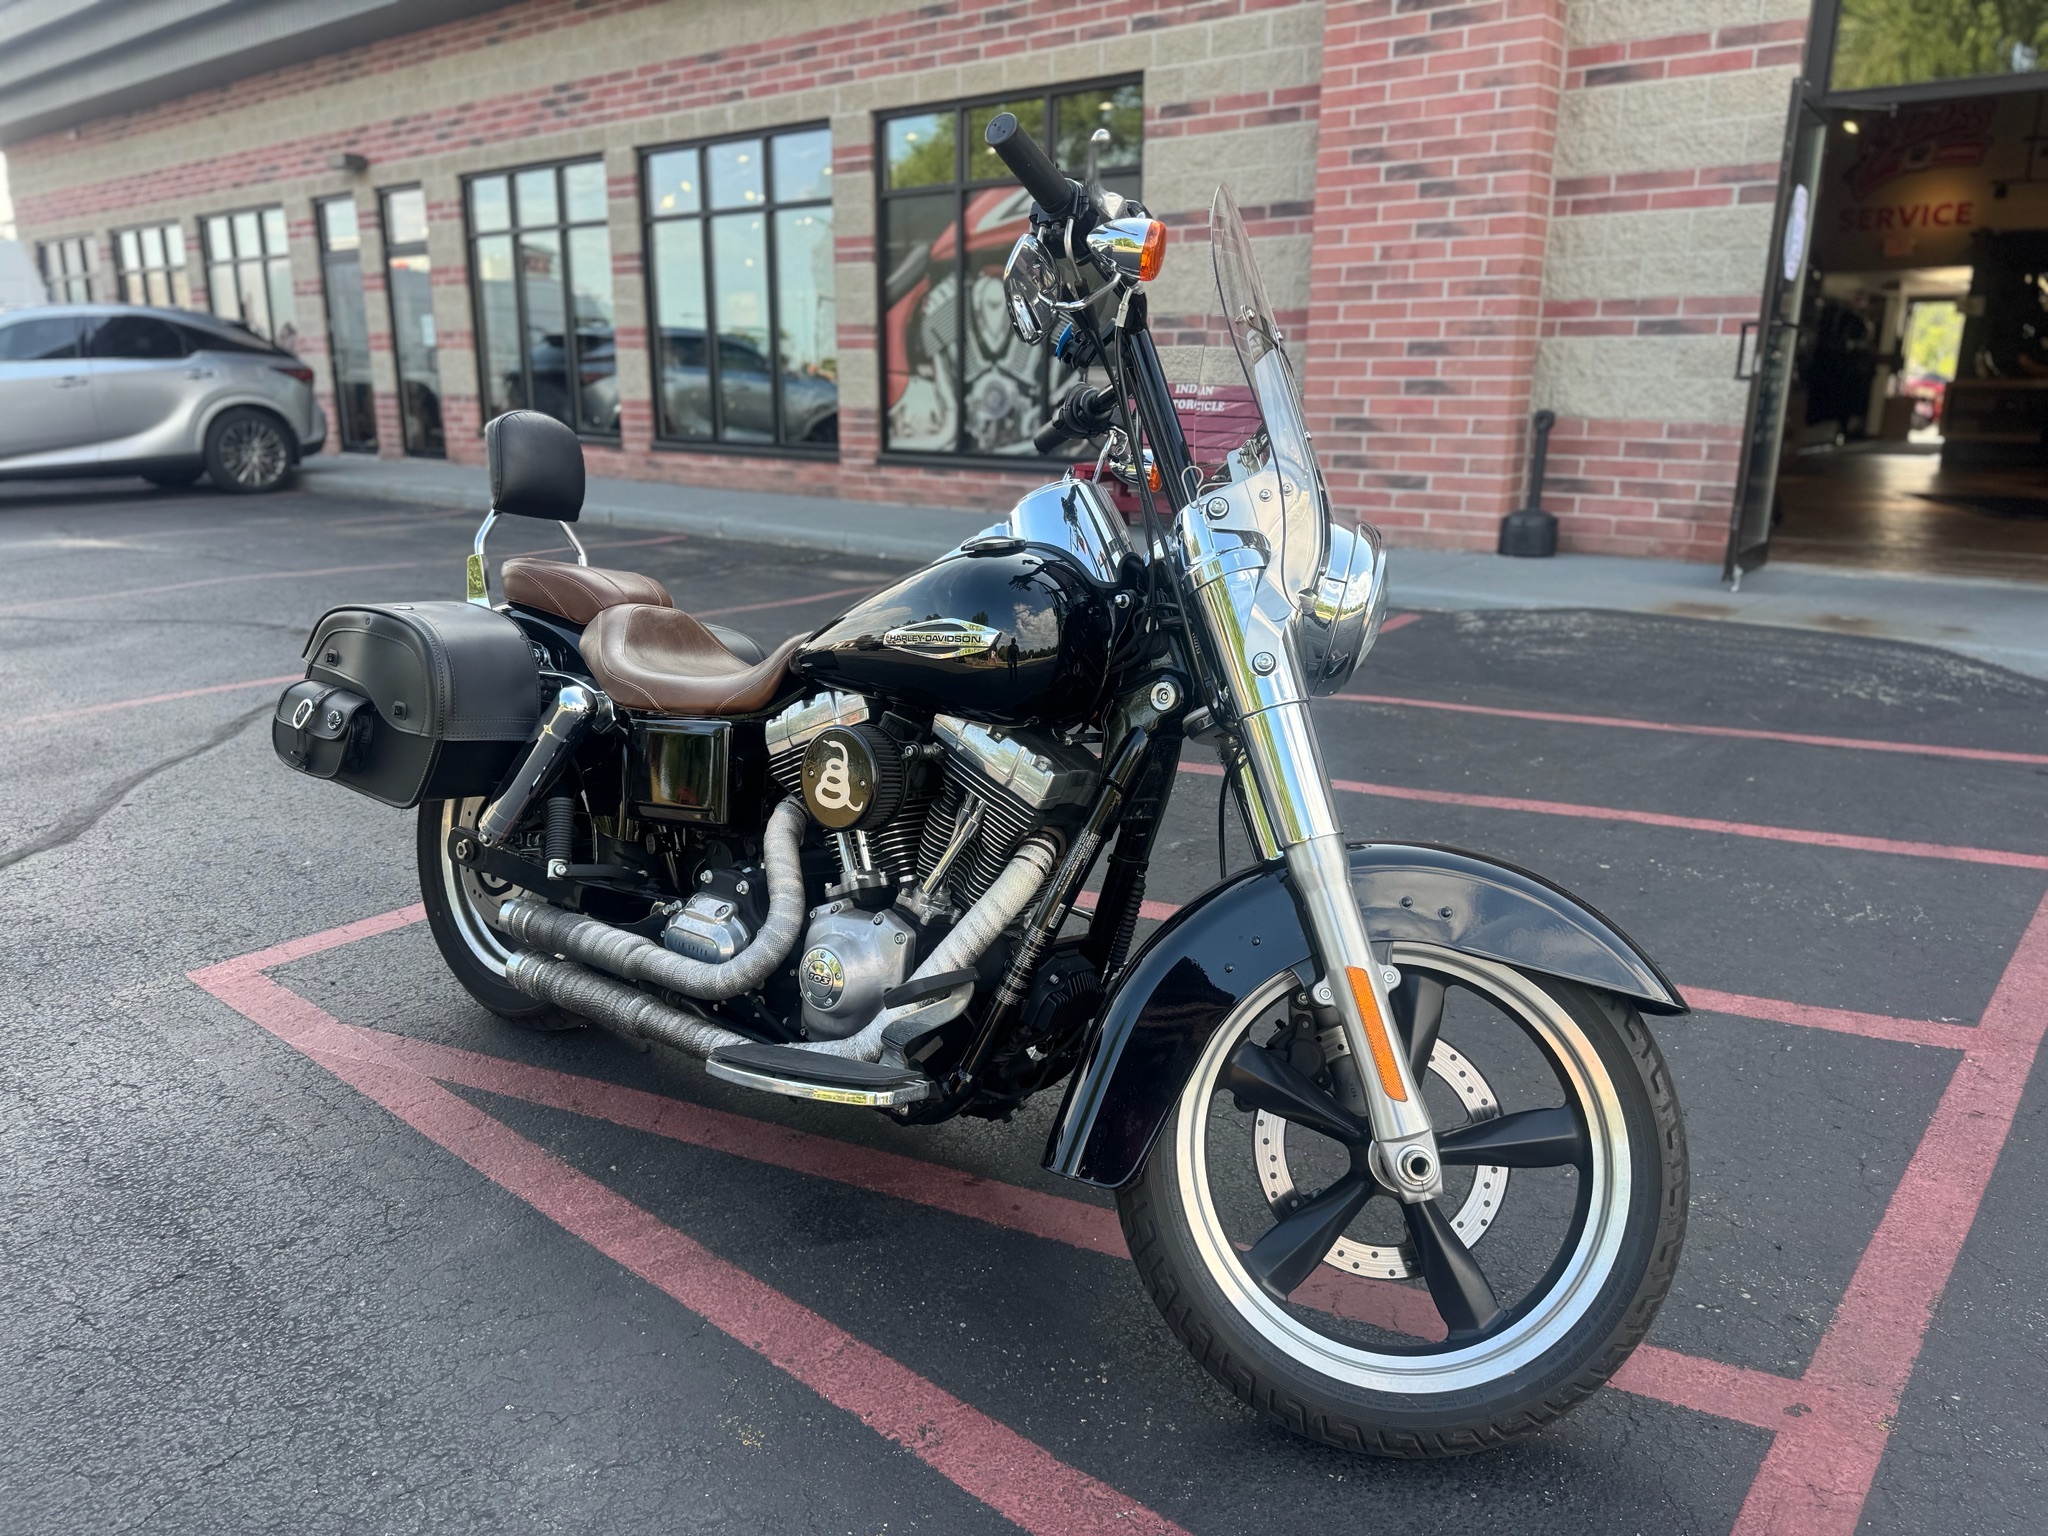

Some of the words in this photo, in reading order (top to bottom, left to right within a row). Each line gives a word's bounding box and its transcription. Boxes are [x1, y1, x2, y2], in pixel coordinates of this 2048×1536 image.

[1838, 202, 1975, 234] SERVICE
[1173, 399, 1225, 412] TORCYCLE
[889, 634, 981, 644] HARLEY-DAVIDSON
[808, 972, 831, 986] 103
